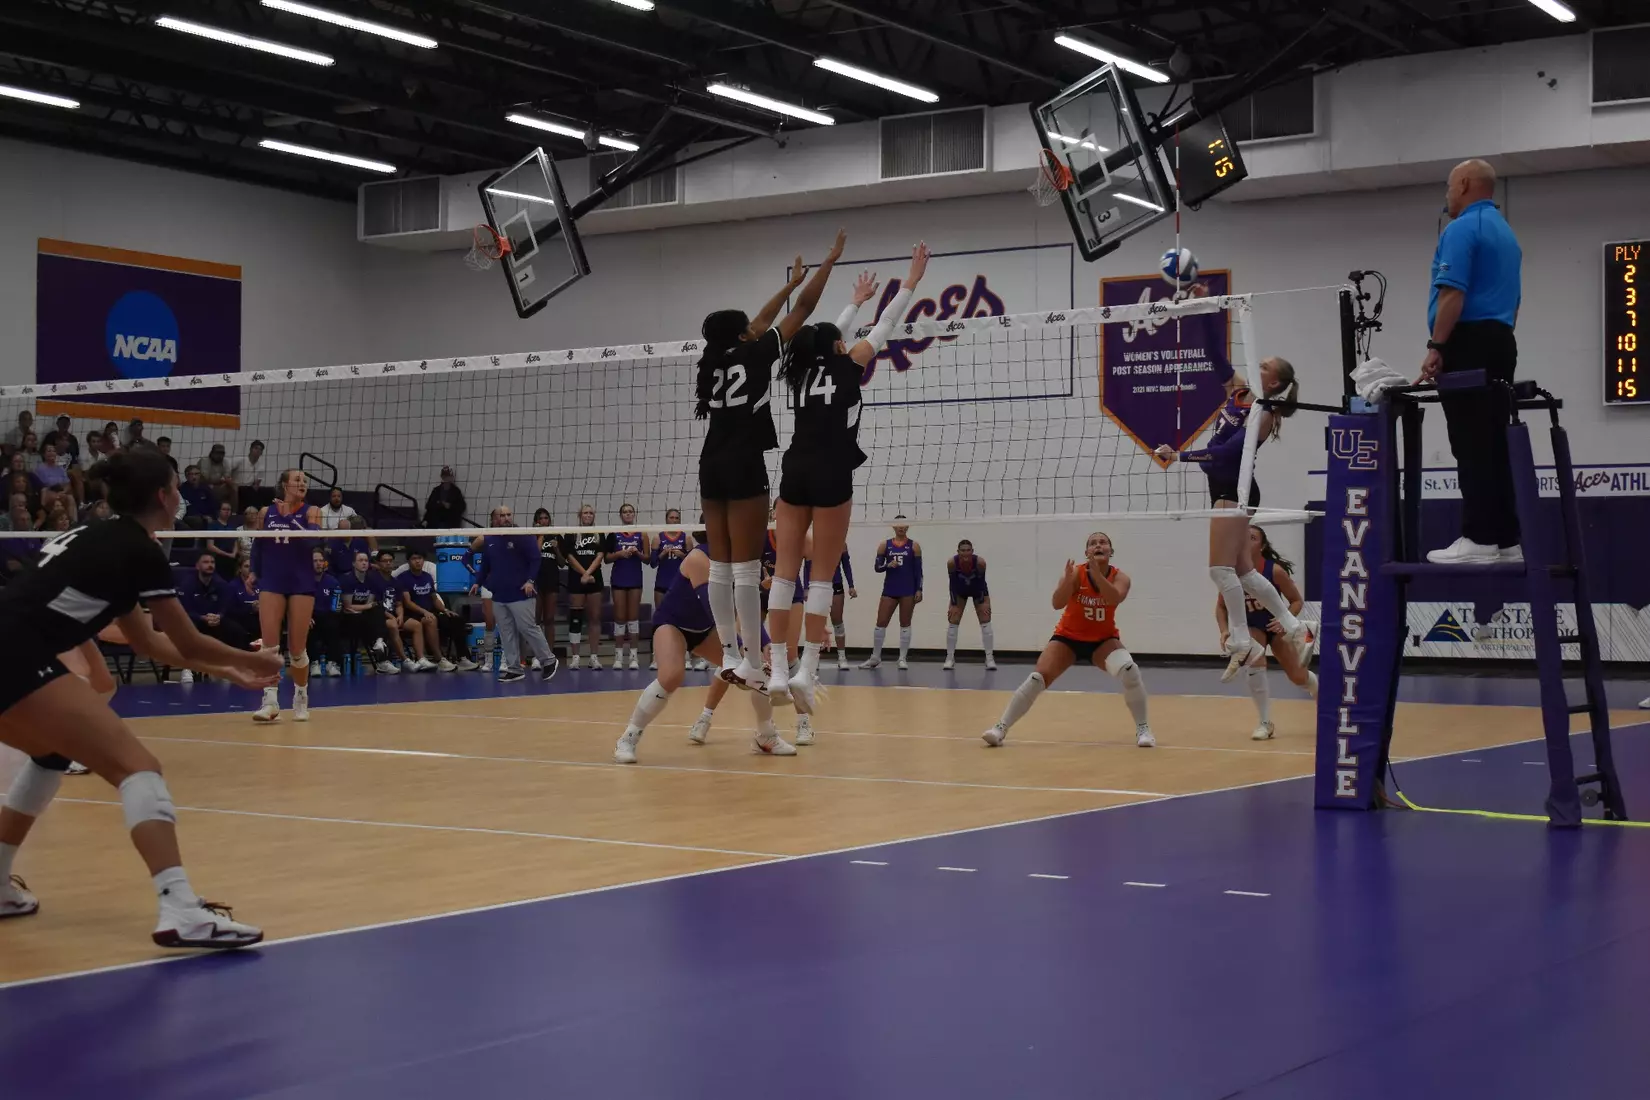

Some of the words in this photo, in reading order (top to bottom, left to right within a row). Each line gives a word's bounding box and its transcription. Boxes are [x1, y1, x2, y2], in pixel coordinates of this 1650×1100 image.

[1098, 210, 1111, 223] 3
[1615, 245, 1641, 262] PLY
[1624, 264, 1636, 283] 2
[1626, 287, 1636, 306] 3
[946, 320, 966, 332] Aces
[998, 317, 1011, 328] UE
[1045, 312, 1066, 324] Aces
[1148, 303, 1168, 315] Aces
[1626, 310, 1636, 327] 7
[113, 334, 177, 363] NCAA
[1617, 332, 1637, 352] 10
[452, 358, 466, 369] Aces
[525, 353, 541, 364] Aces
[601, 347, 617, 359] Aces
[681, 341, 698, 353] Aces
[1123, 350, 1159, 362] WOMEN'S
[1112, 365, 1132, 376] POST
[1133, 364, 1163, 375] SEASON
[1617, 357, 1637, 373] 11
[709, 364, 749, 408] 22
[1617, 378, 1637, 398] 15
[1331, 428, 1378, 470] UE
[1424, 478, 1441, 490] St.
[1083, 606, 1106, 622] 20
[1335, 487, 1369, 798] EVANSVILLE
